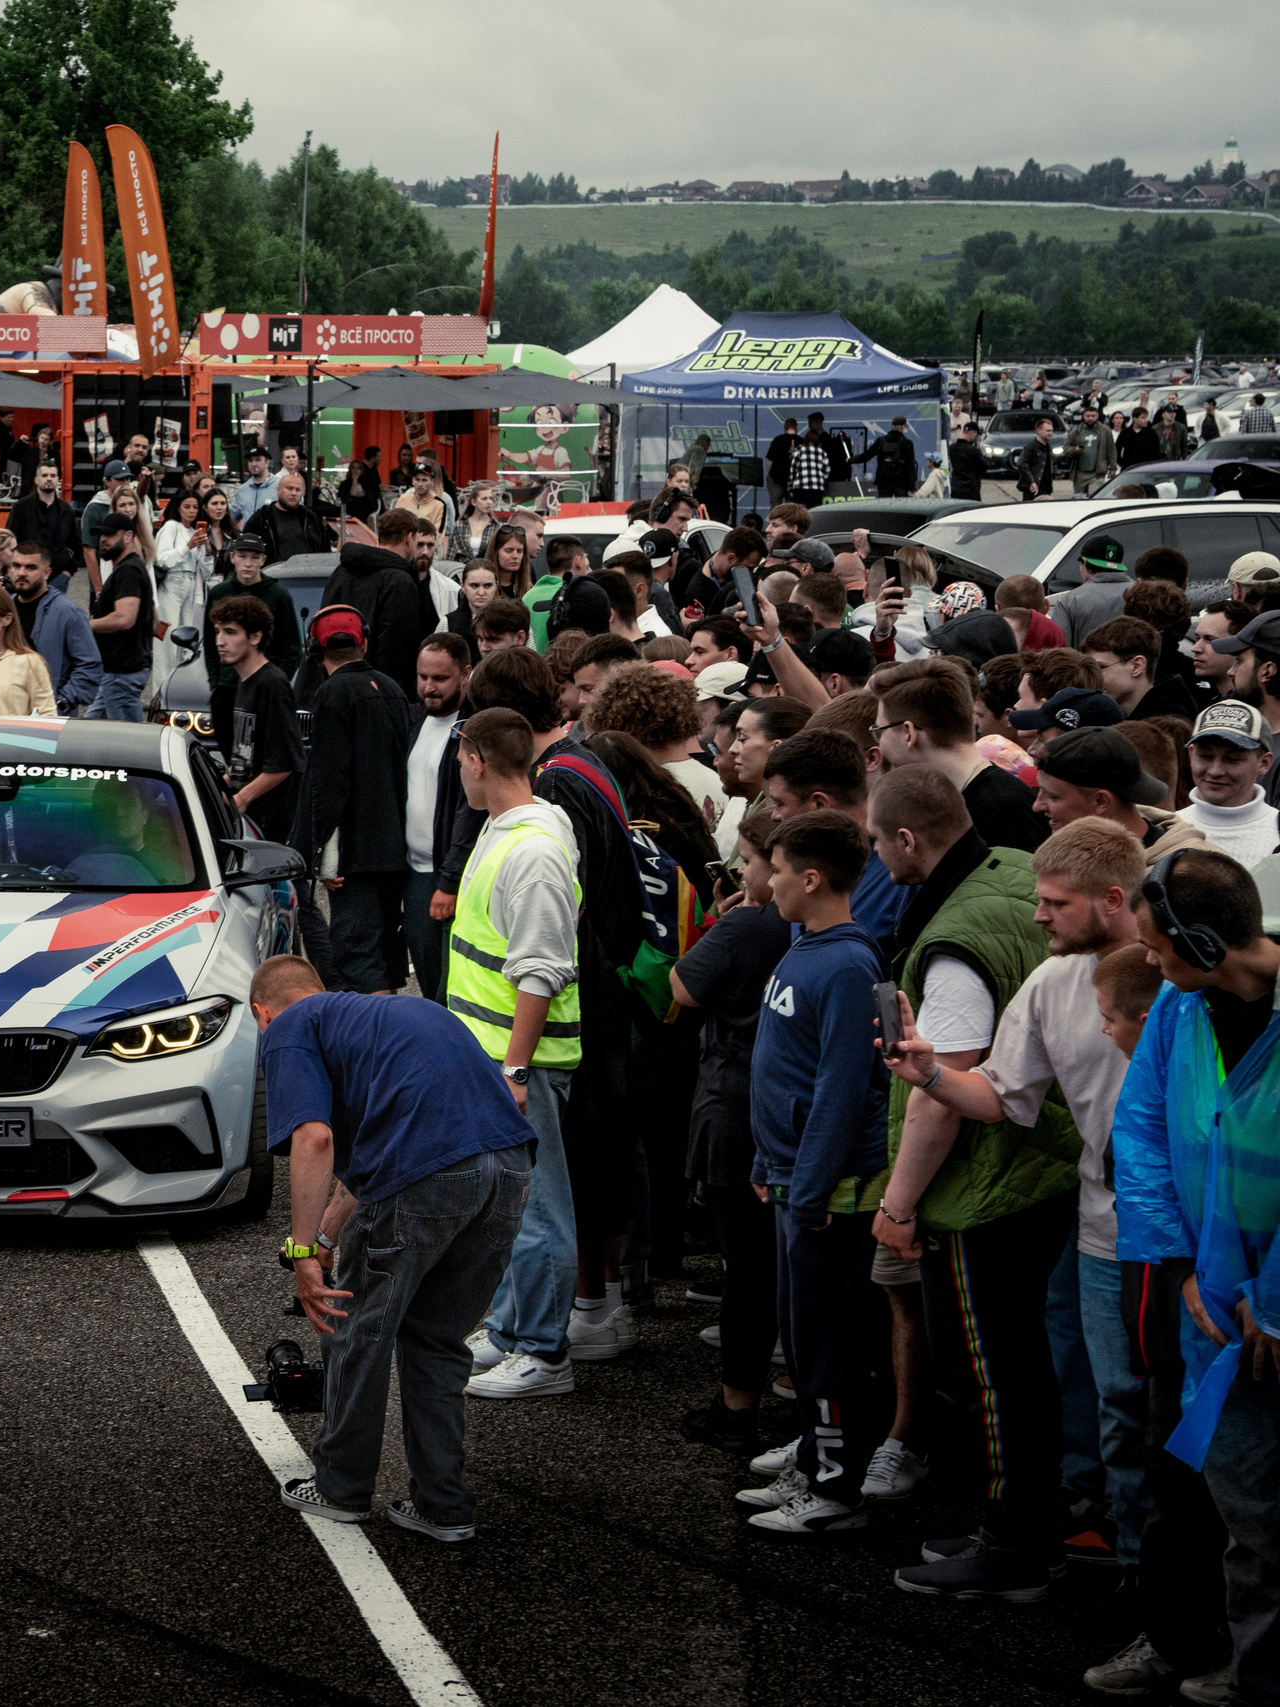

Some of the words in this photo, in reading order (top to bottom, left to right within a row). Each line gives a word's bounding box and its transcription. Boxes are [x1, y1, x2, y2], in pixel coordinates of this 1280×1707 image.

[128, 150, 144, 208] ПРОСТО
[340, 326, 363, 344] ВСЁ
[364, 329, 414, 344] ПРОСТО
[634, 385, 655, 394] LIFE
[657, 386, 683, 395] pulse
[723, 385, 834, 399] DIKARSHINA
[877, 385, 900, 394] LIFE
[902, 383, 929, 393] pulse
[815, 1398, 844, 1483] FILA
